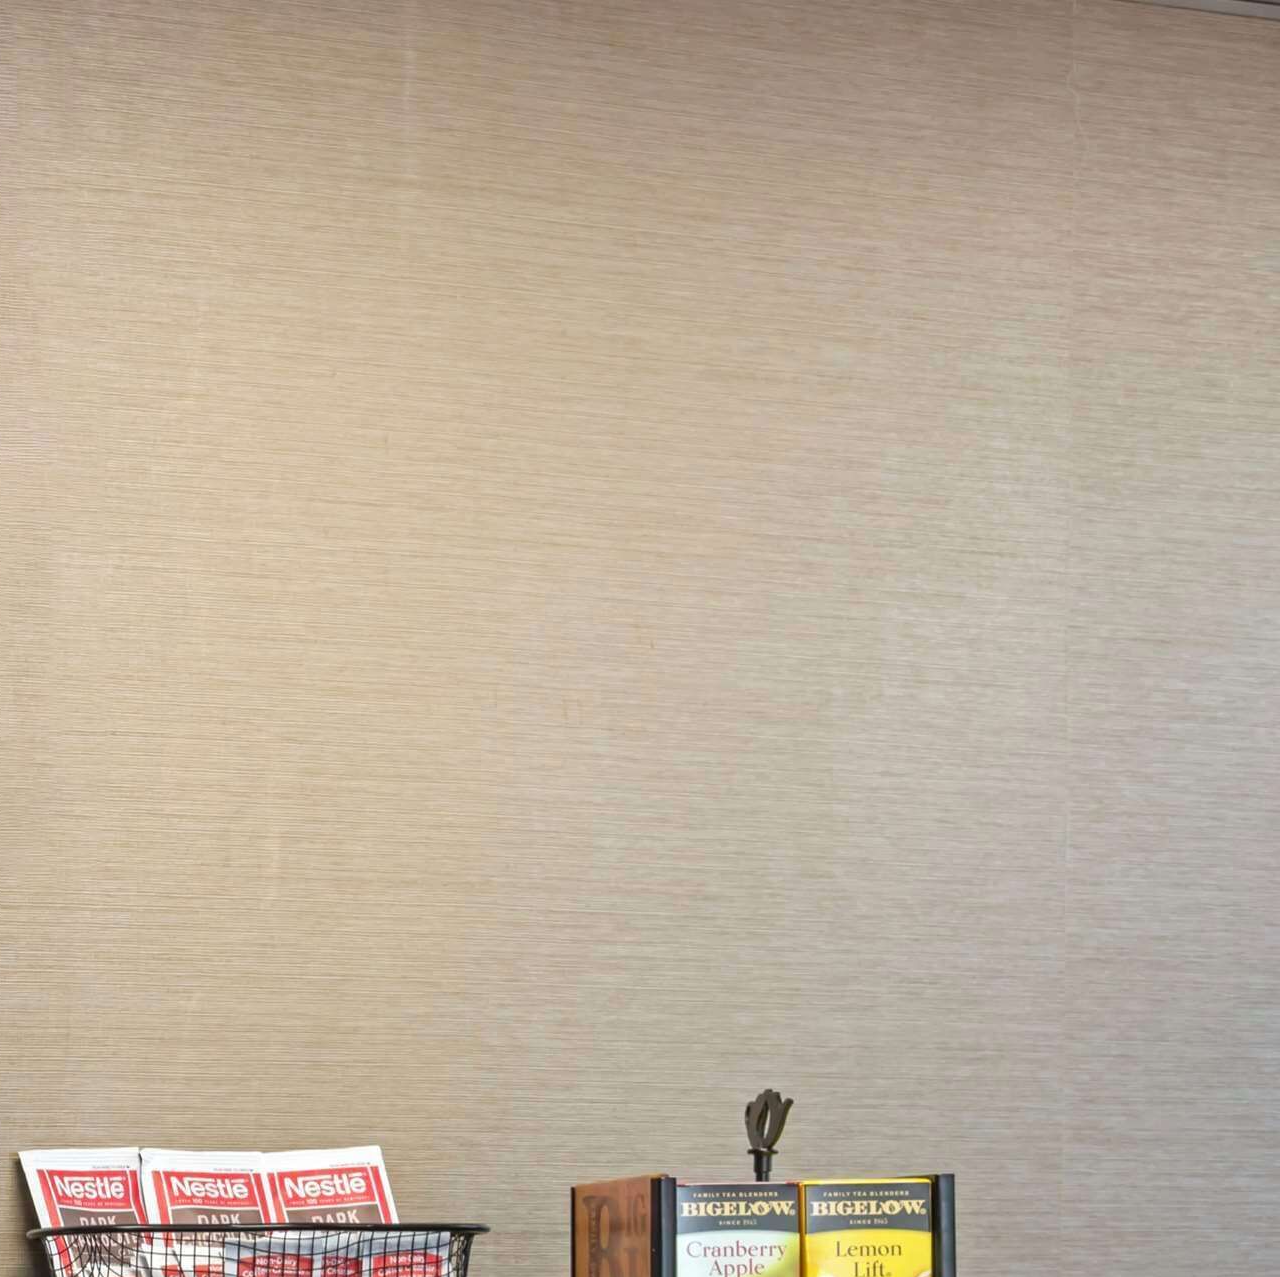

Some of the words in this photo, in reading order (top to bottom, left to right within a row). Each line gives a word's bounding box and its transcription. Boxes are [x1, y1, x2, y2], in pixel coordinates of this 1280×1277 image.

[53, 1175, 125, 1199] Nestlé
[169, 1176, 249, 1200] Nestlé
[283, 1172, 366, 1199] Nestlé
[311, 1209, 360, 1224] DARK
[681, 1200, 795, 1217] BIGELOW
[810, 1200, 926, 1216] BIGELOW
[79, 1215, 116, 1226] DARK
[197, 1214, 241, 1225] DARK
[686, 1240, 786, 1262] Cranberry
[835, 1240, 902, 1258] Lemon
